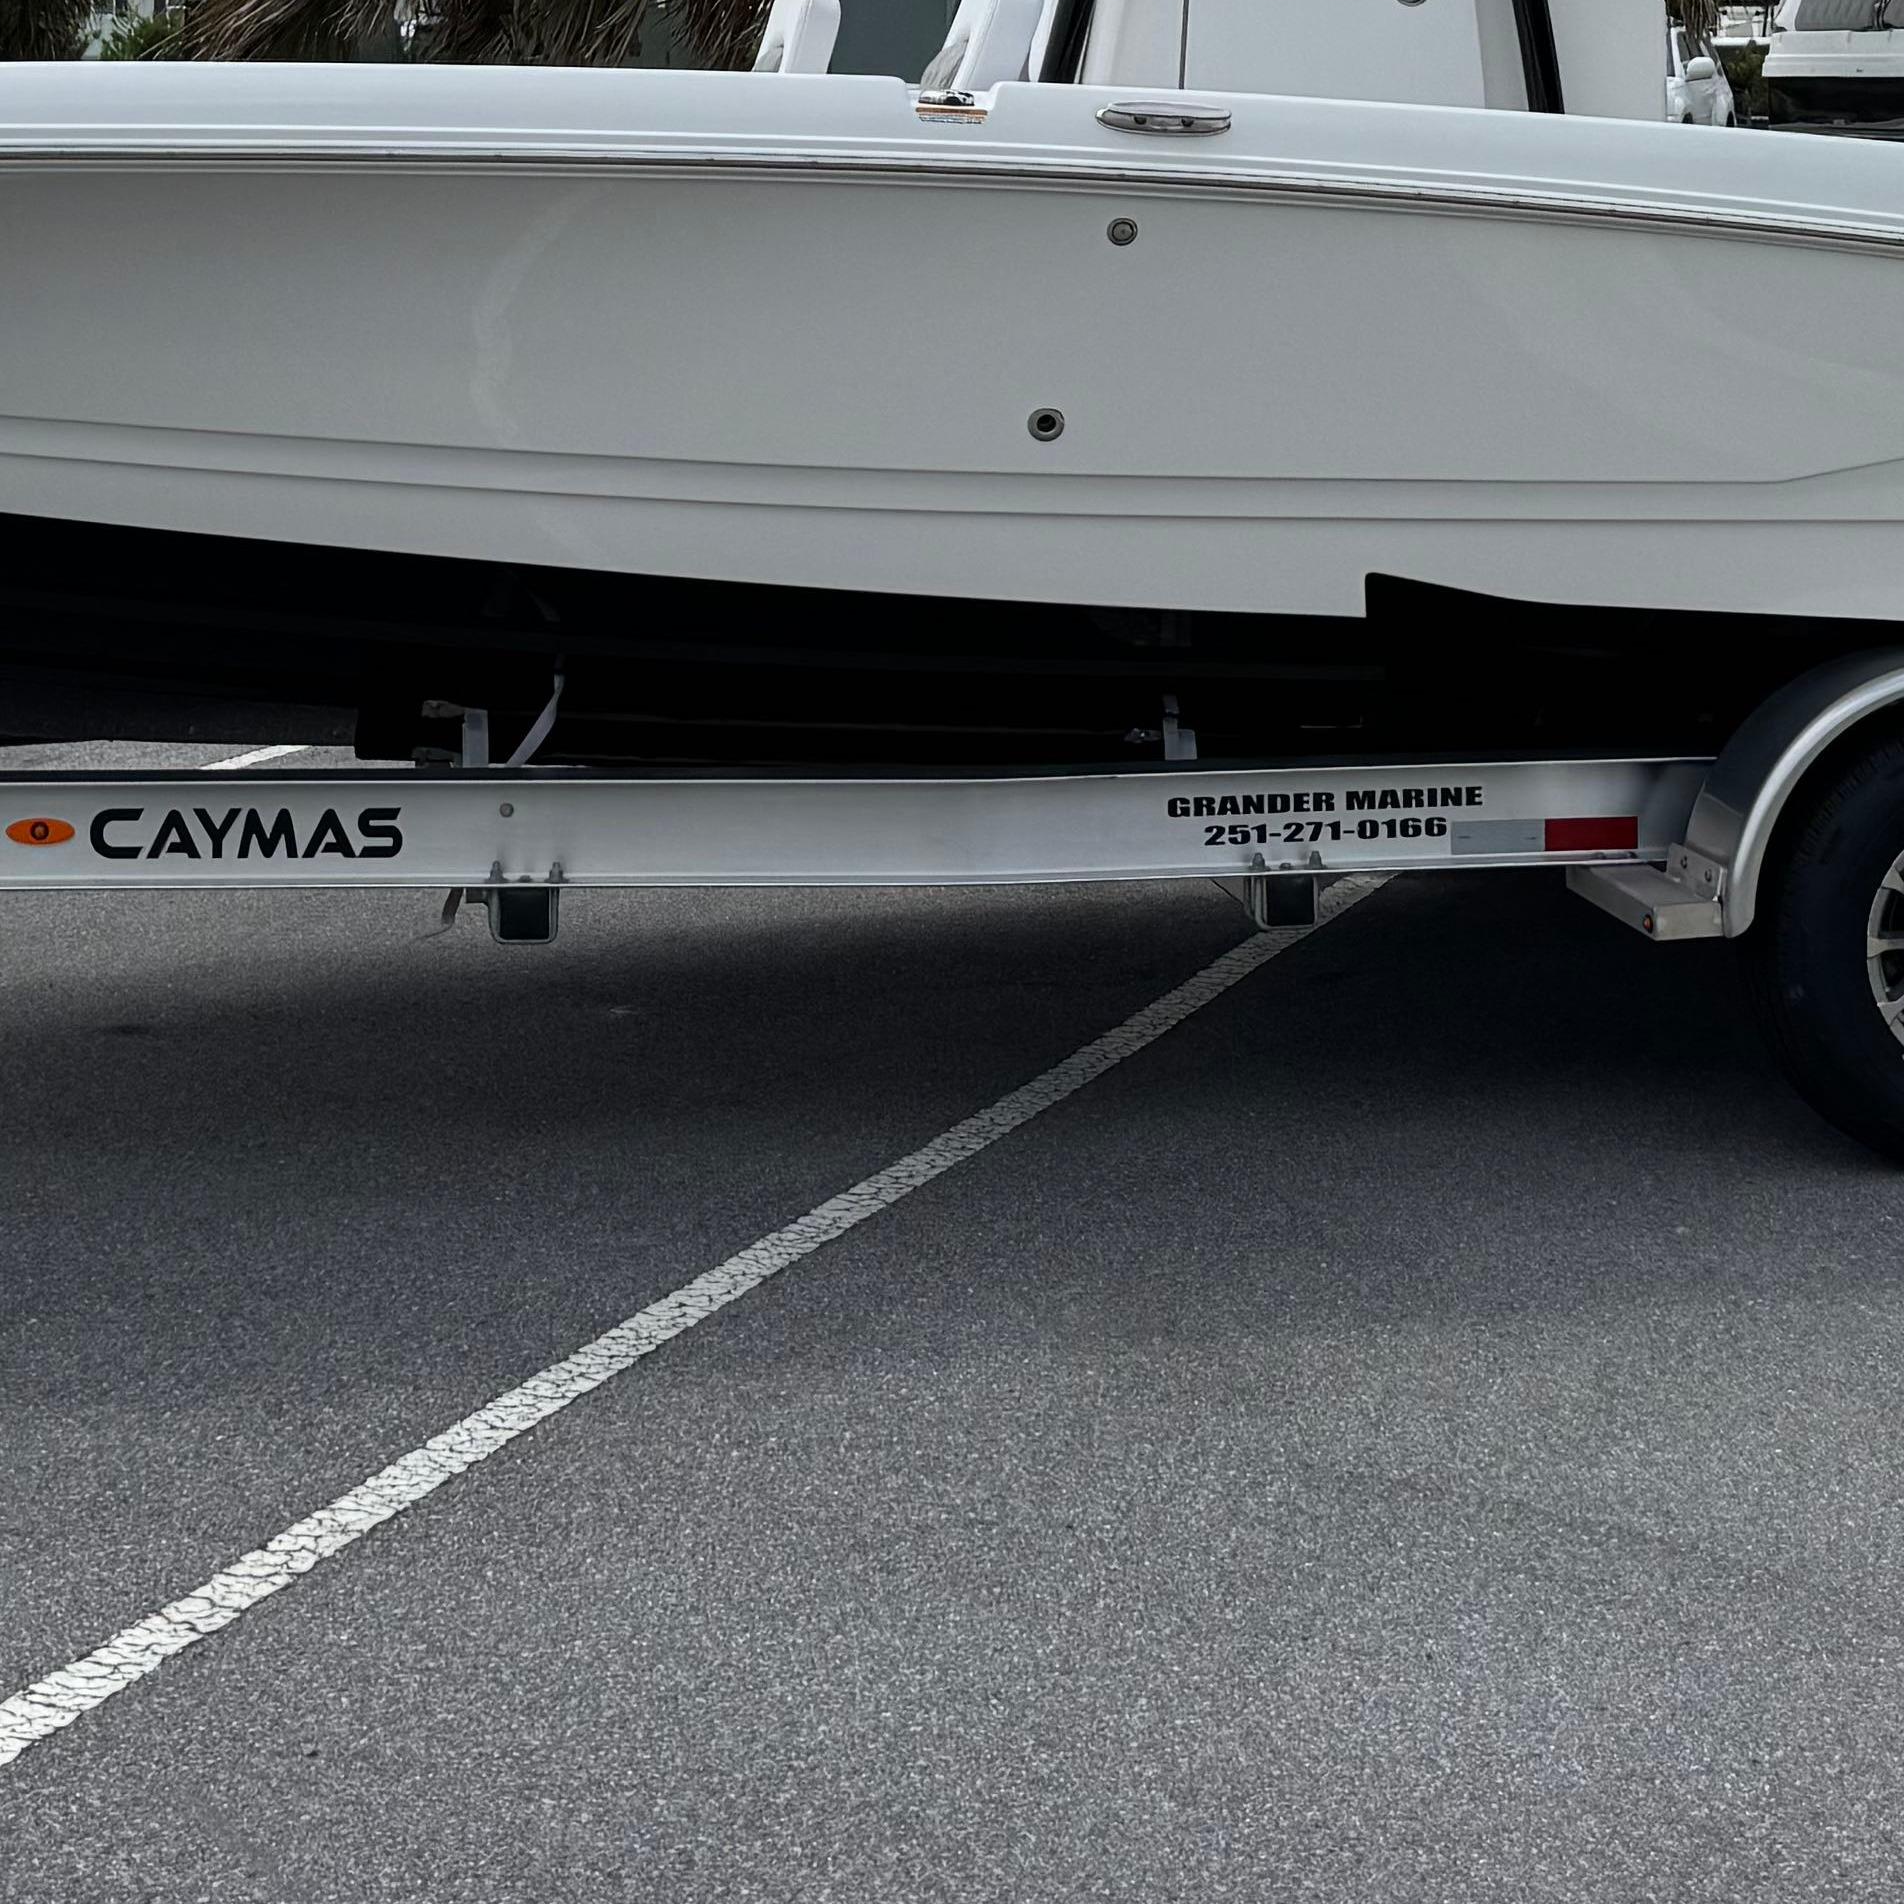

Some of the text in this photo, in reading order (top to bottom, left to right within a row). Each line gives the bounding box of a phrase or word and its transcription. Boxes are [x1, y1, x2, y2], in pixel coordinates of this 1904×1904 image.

[1167, 786, 1484, 817] GRANDER MARINE
[89, 807, 404, 859] CAYMAS
[1204, 816, 1448, 847] 251-271-0166
